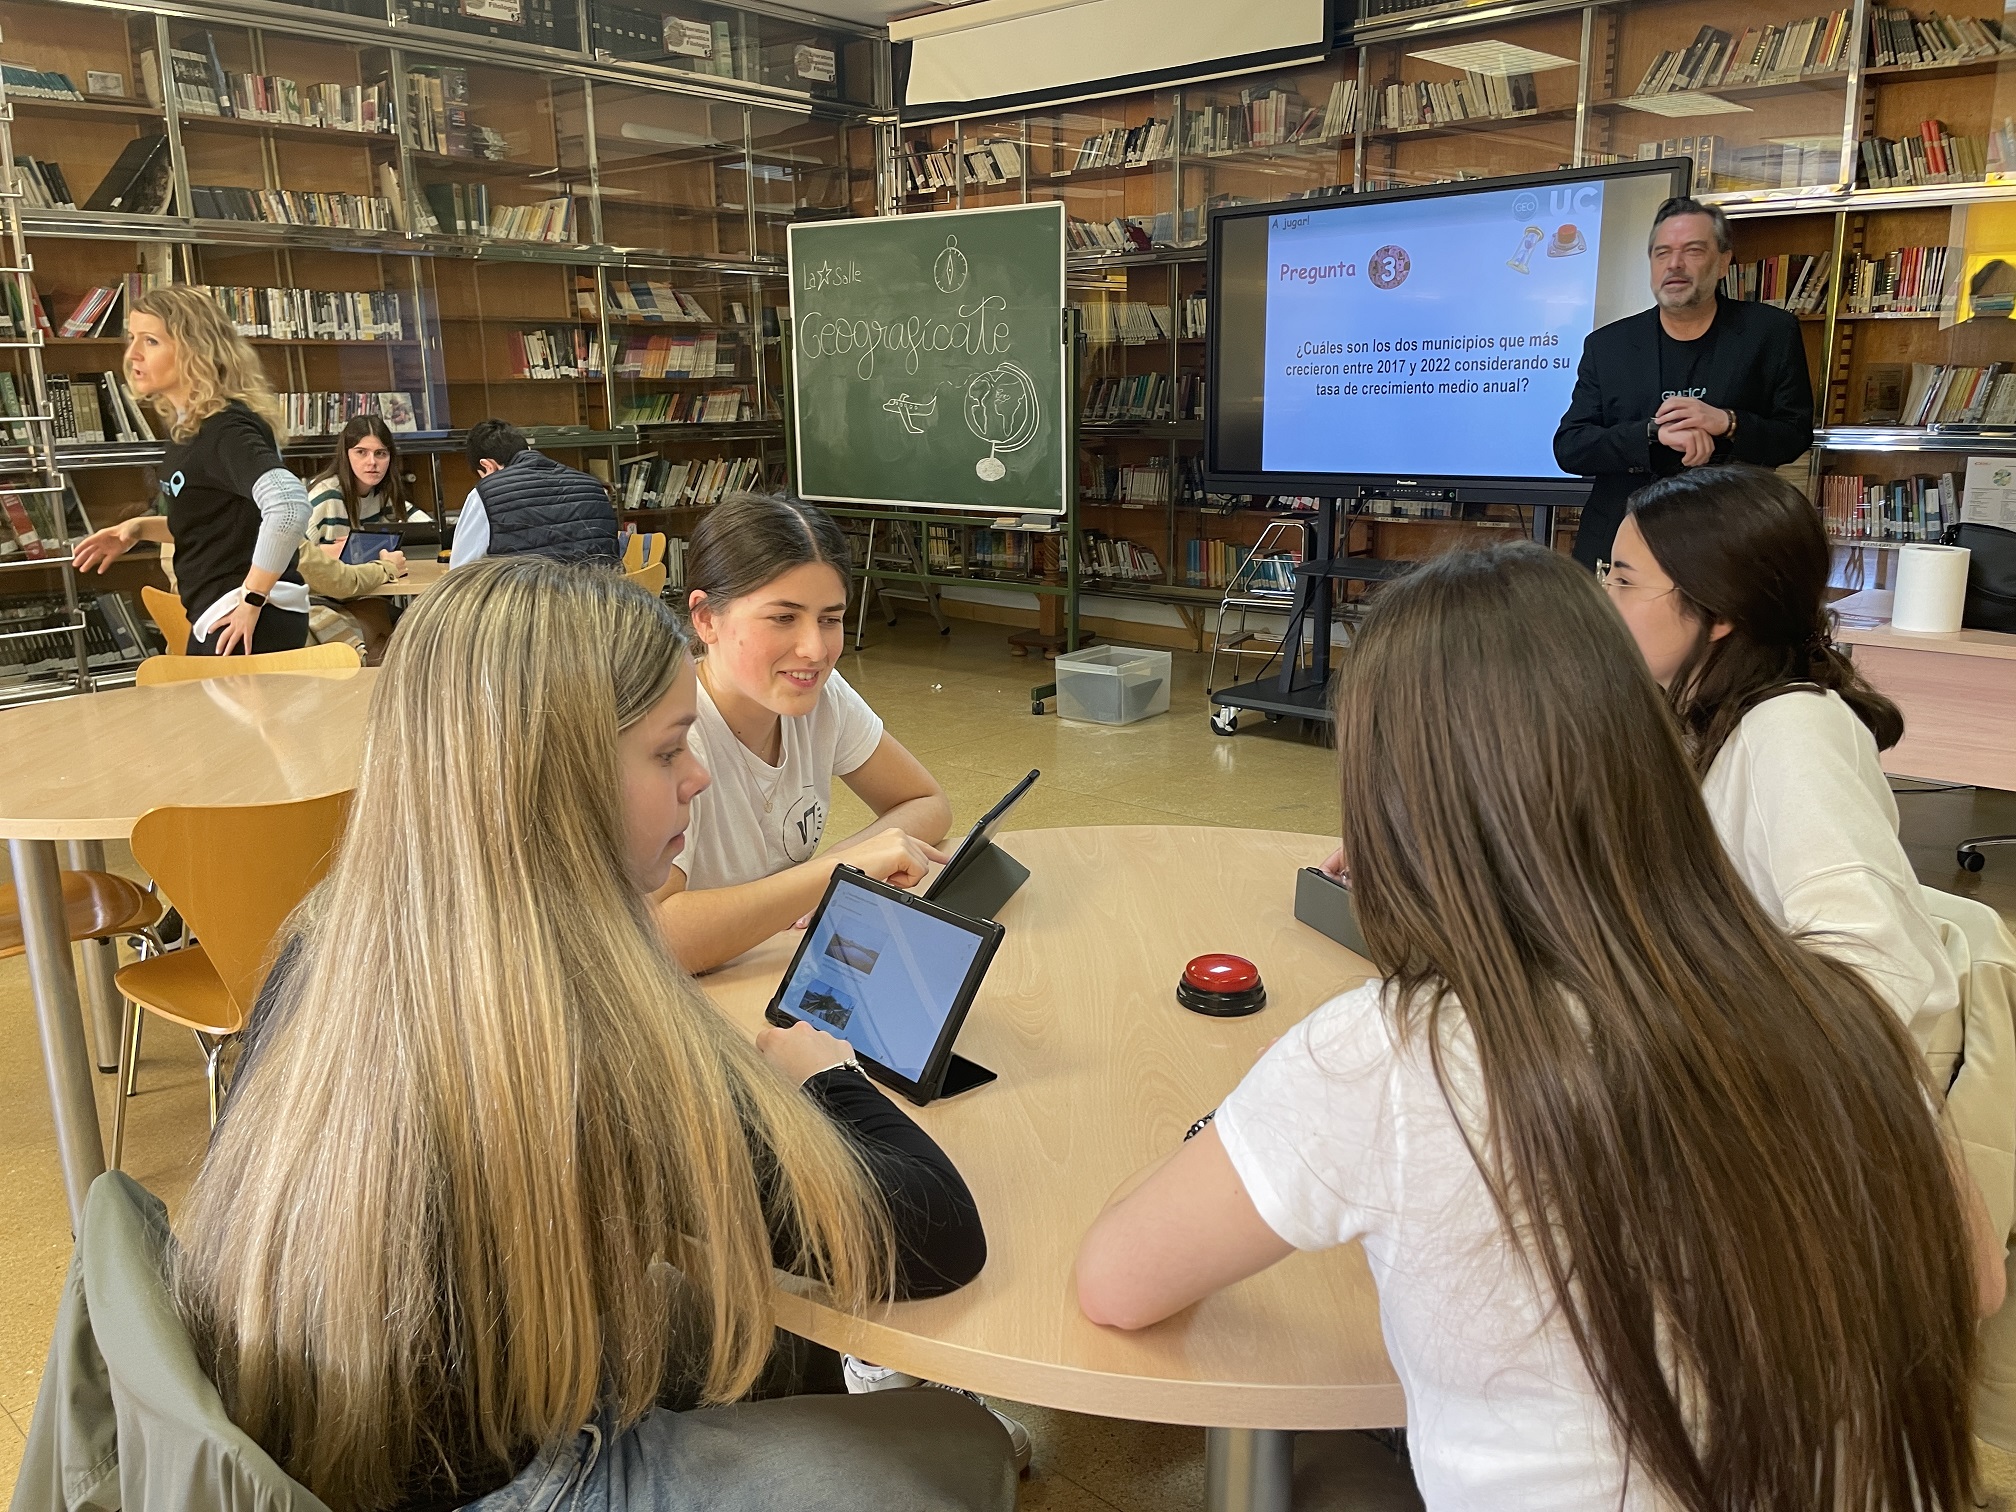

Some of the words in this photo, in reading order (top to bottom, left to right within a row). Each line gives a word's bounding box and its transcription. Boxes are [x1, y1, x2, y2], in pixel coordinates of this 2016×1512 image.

[1514, 200, 1536, 212] GEO
[1549, 186, 1599, 217] UC
[1271, 218, 1279, 229] A
[802, 262, 817, 291] La
[832, 260, 862, 286] Salle
[1280, 261, 1356, 285] Pregunta
[1381, 256, 1397, 282] 3
[1296, 340, 1343, 359] ¿Cuáles
[1346, 342, 1369, 354] son
[1372, 338, 1391, 353] los
[1395, 337, 1418, 352] dos
[1422, 334, 1495, 352] municipios
[1499, 335, 1525, 351] que
[1529, 332, 1559, 347] más
[1285, 362, 1339, 376] crecieron
[1343, 361, 1374, 375] entre
[1377, 359, 1406, 374] 2017
[1409, 362, 1417, 376] y
[1420, 358, 1450, 373] 2022
[1454, 354, 1549, 371] considerando
[1552, 357, 1571, 369] su
[1316, 383, 1340, 396] tasa
[1343, 381, 1358, 395] de
[1361, 380, 1435, 395] crecimiento
[1438, 378, 1479, 394] medio
[1482, 377, 1530, 393] anual?
